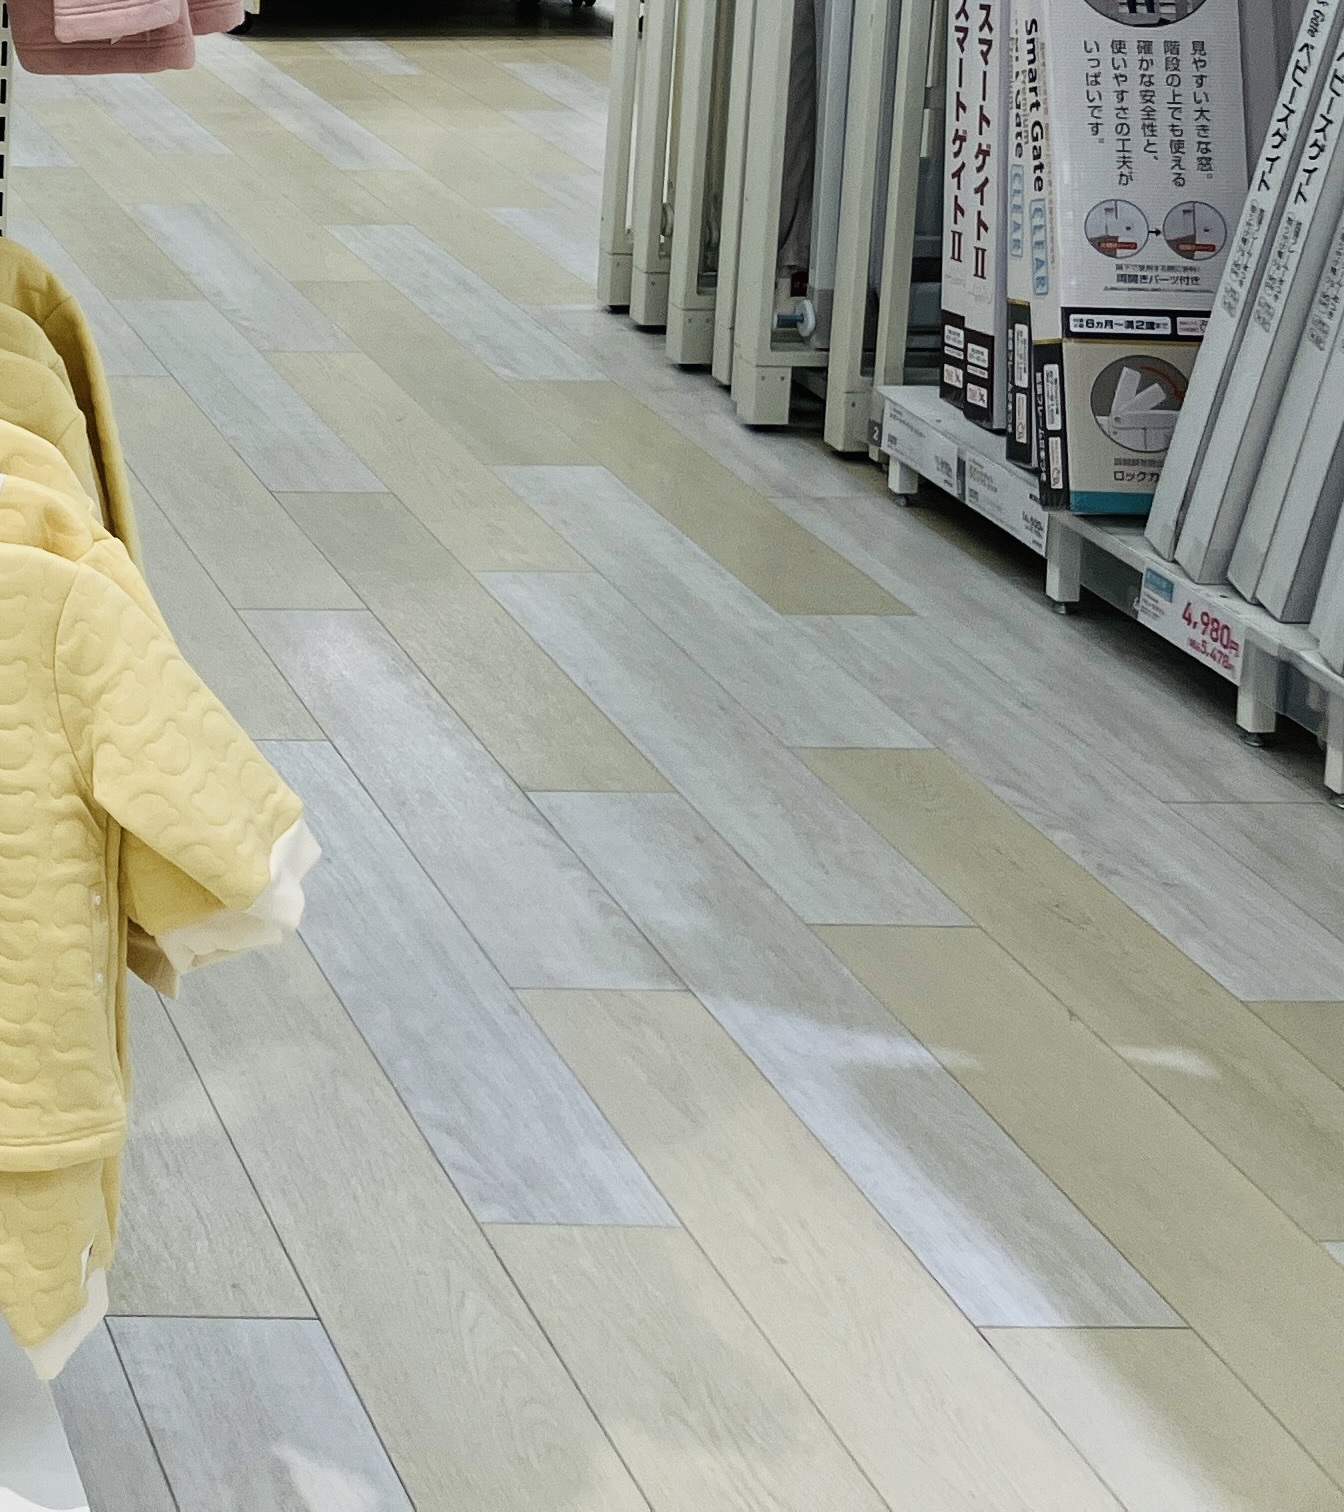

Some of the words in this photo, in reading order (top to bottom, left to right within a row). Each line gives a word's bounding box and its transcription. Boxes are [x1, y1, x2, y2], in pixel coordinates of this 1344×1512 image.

[1025, 18, 1042, 112] Smart
[1084, 40, 1105, 144] いっぱいです。
[1111, 40, 1133, 186] 使いやすさの工夫が
[1137, 40, 1158, 160] 確かな安全性と、
[1163, 40, 1186, 187] 階段の上でも使える
[1192, 40, 1213, 179] 見やすい大きな窓。
[1031, 119, 1045, 192] Gate
[1033, 206, 1047, 289] CLEAR
